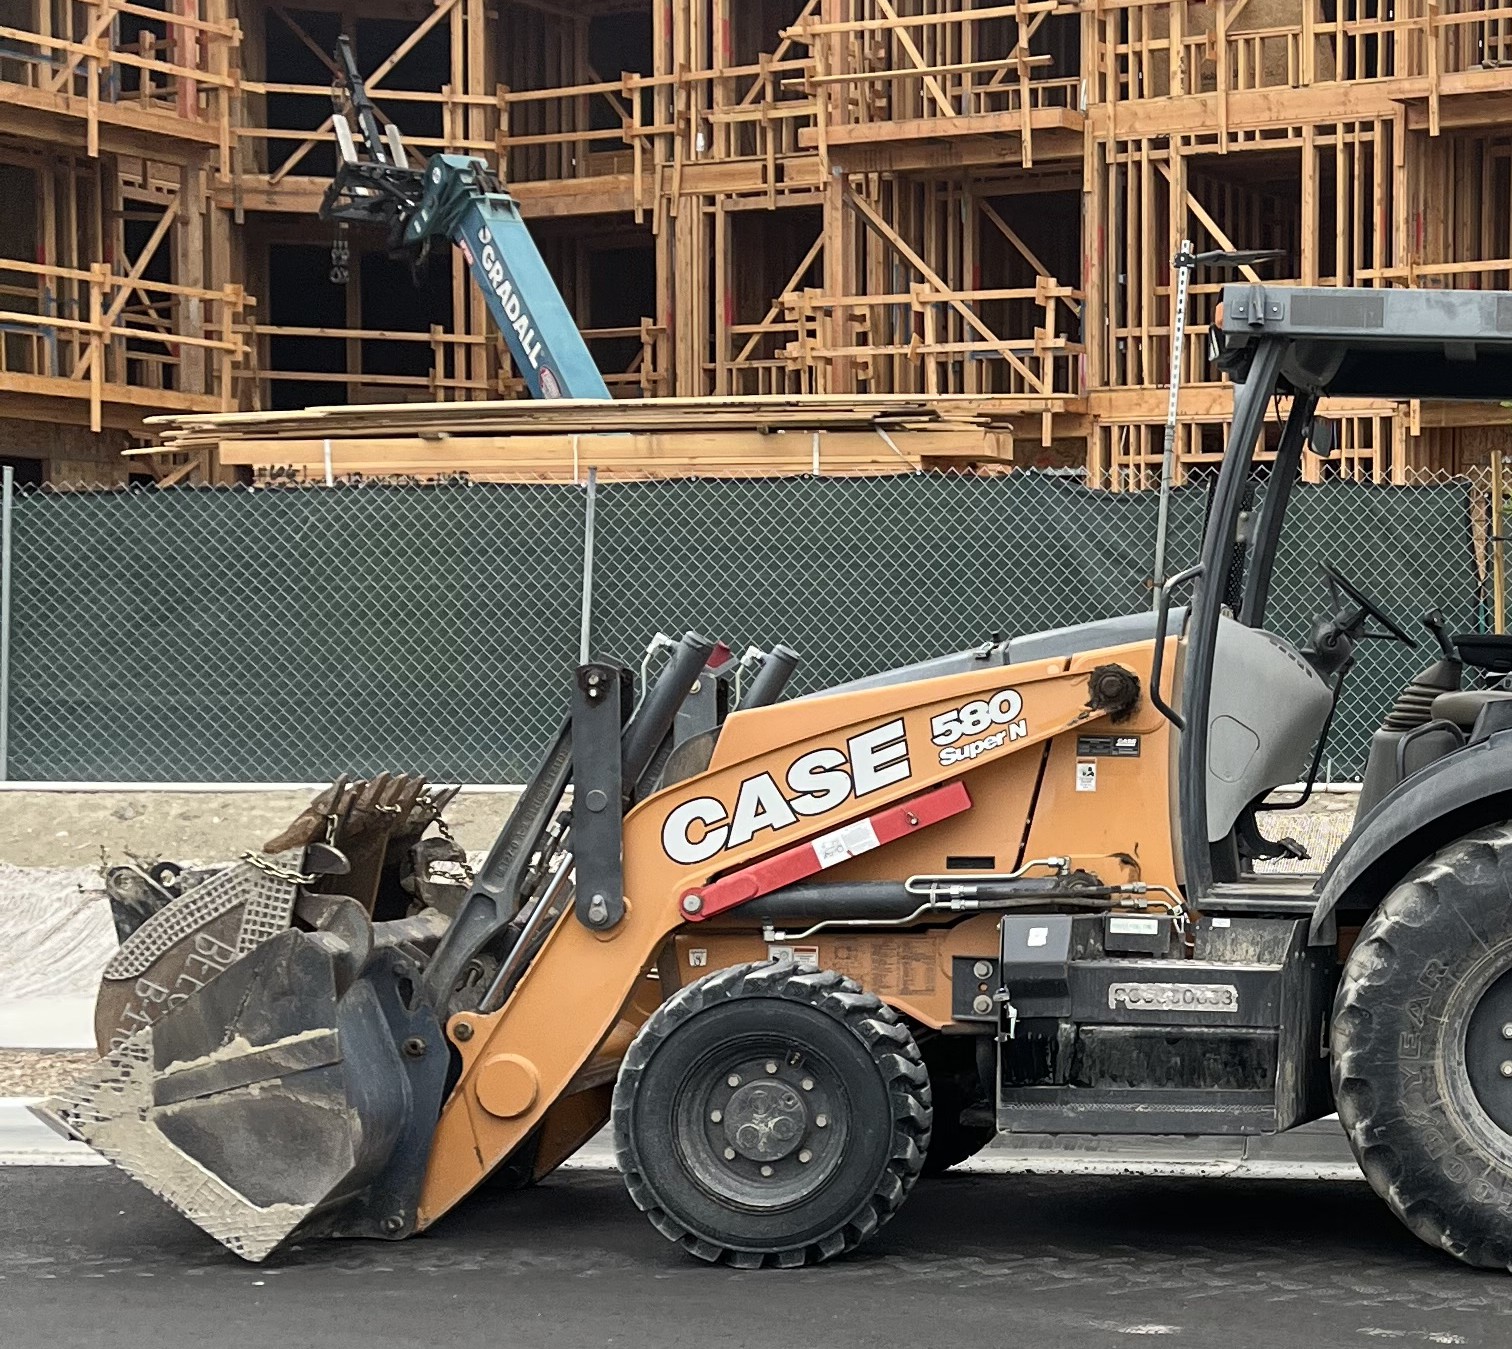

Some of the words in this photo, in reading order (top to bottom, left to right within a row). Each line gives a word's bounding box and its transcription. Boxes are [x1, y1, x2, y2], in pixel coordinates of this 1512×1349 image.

[481, 245, 541, 369] GRADALL
[661, 717, 912, 865] CASE
[930, 688, 1023, 746] 580
[938, 729, 1007, 766] Super
[1008, 718, 1027, 742] N
